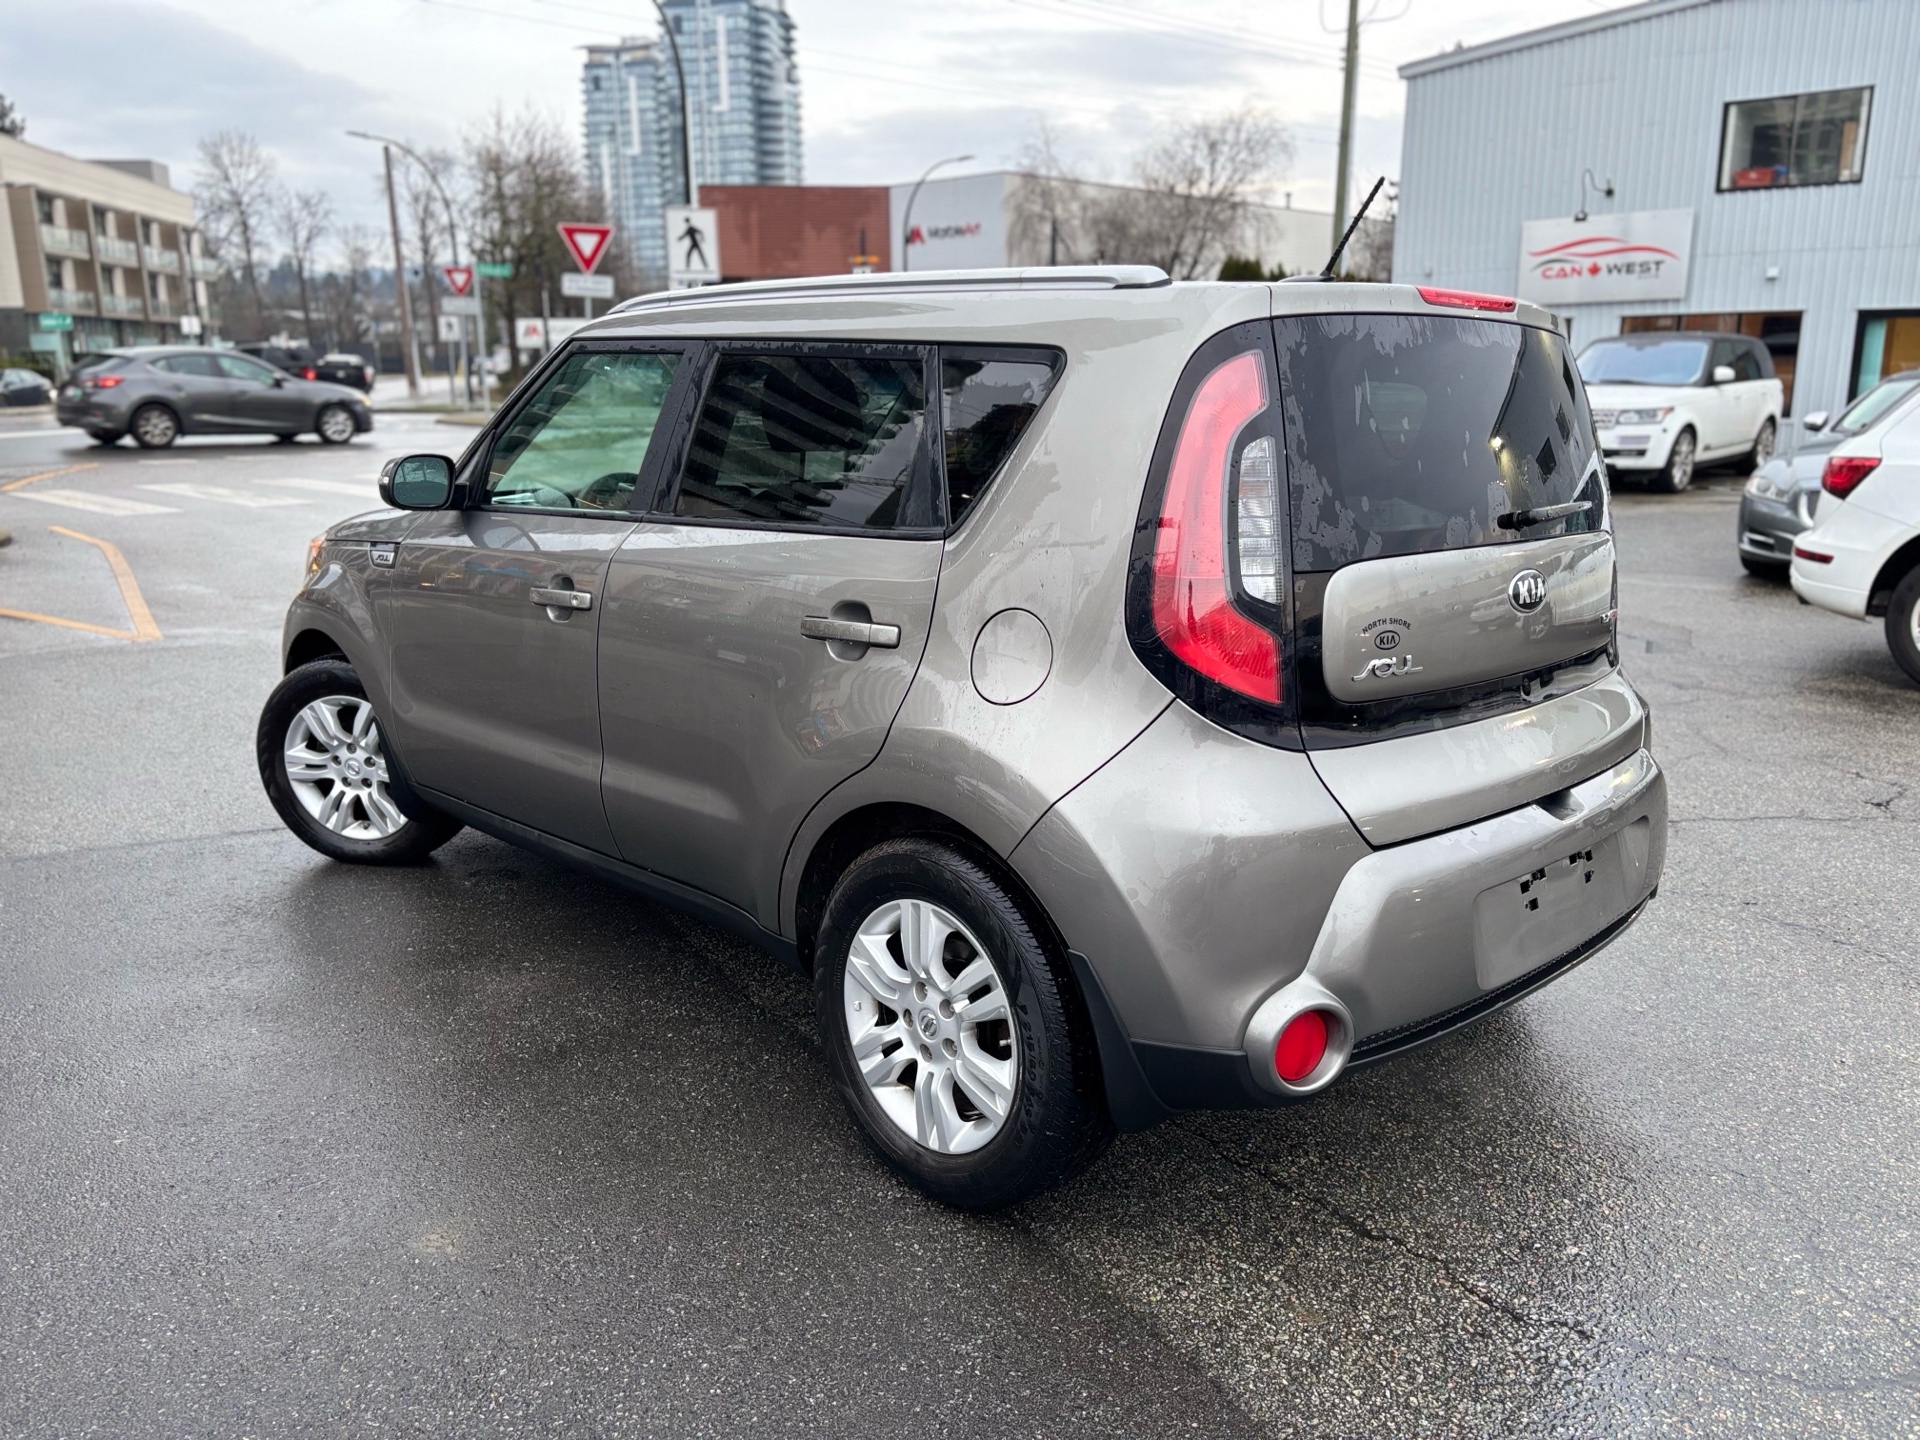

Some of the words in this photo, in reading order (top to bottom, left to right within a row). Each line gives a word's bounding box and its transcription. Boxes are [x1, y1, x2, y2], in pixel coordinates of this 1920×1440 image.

[1541, 265, 1582, 280] CAN
[1607, 260, 1664, 275] WEST
[1517, 577, 1545, 604] KIA
[1362, 617, 1387, 635] NORTH
[1389, 617, 1412, 630] SHORE
[1379, 634, 1396, 646] KIA
[1351, 654, 1423, 681] SOUL
